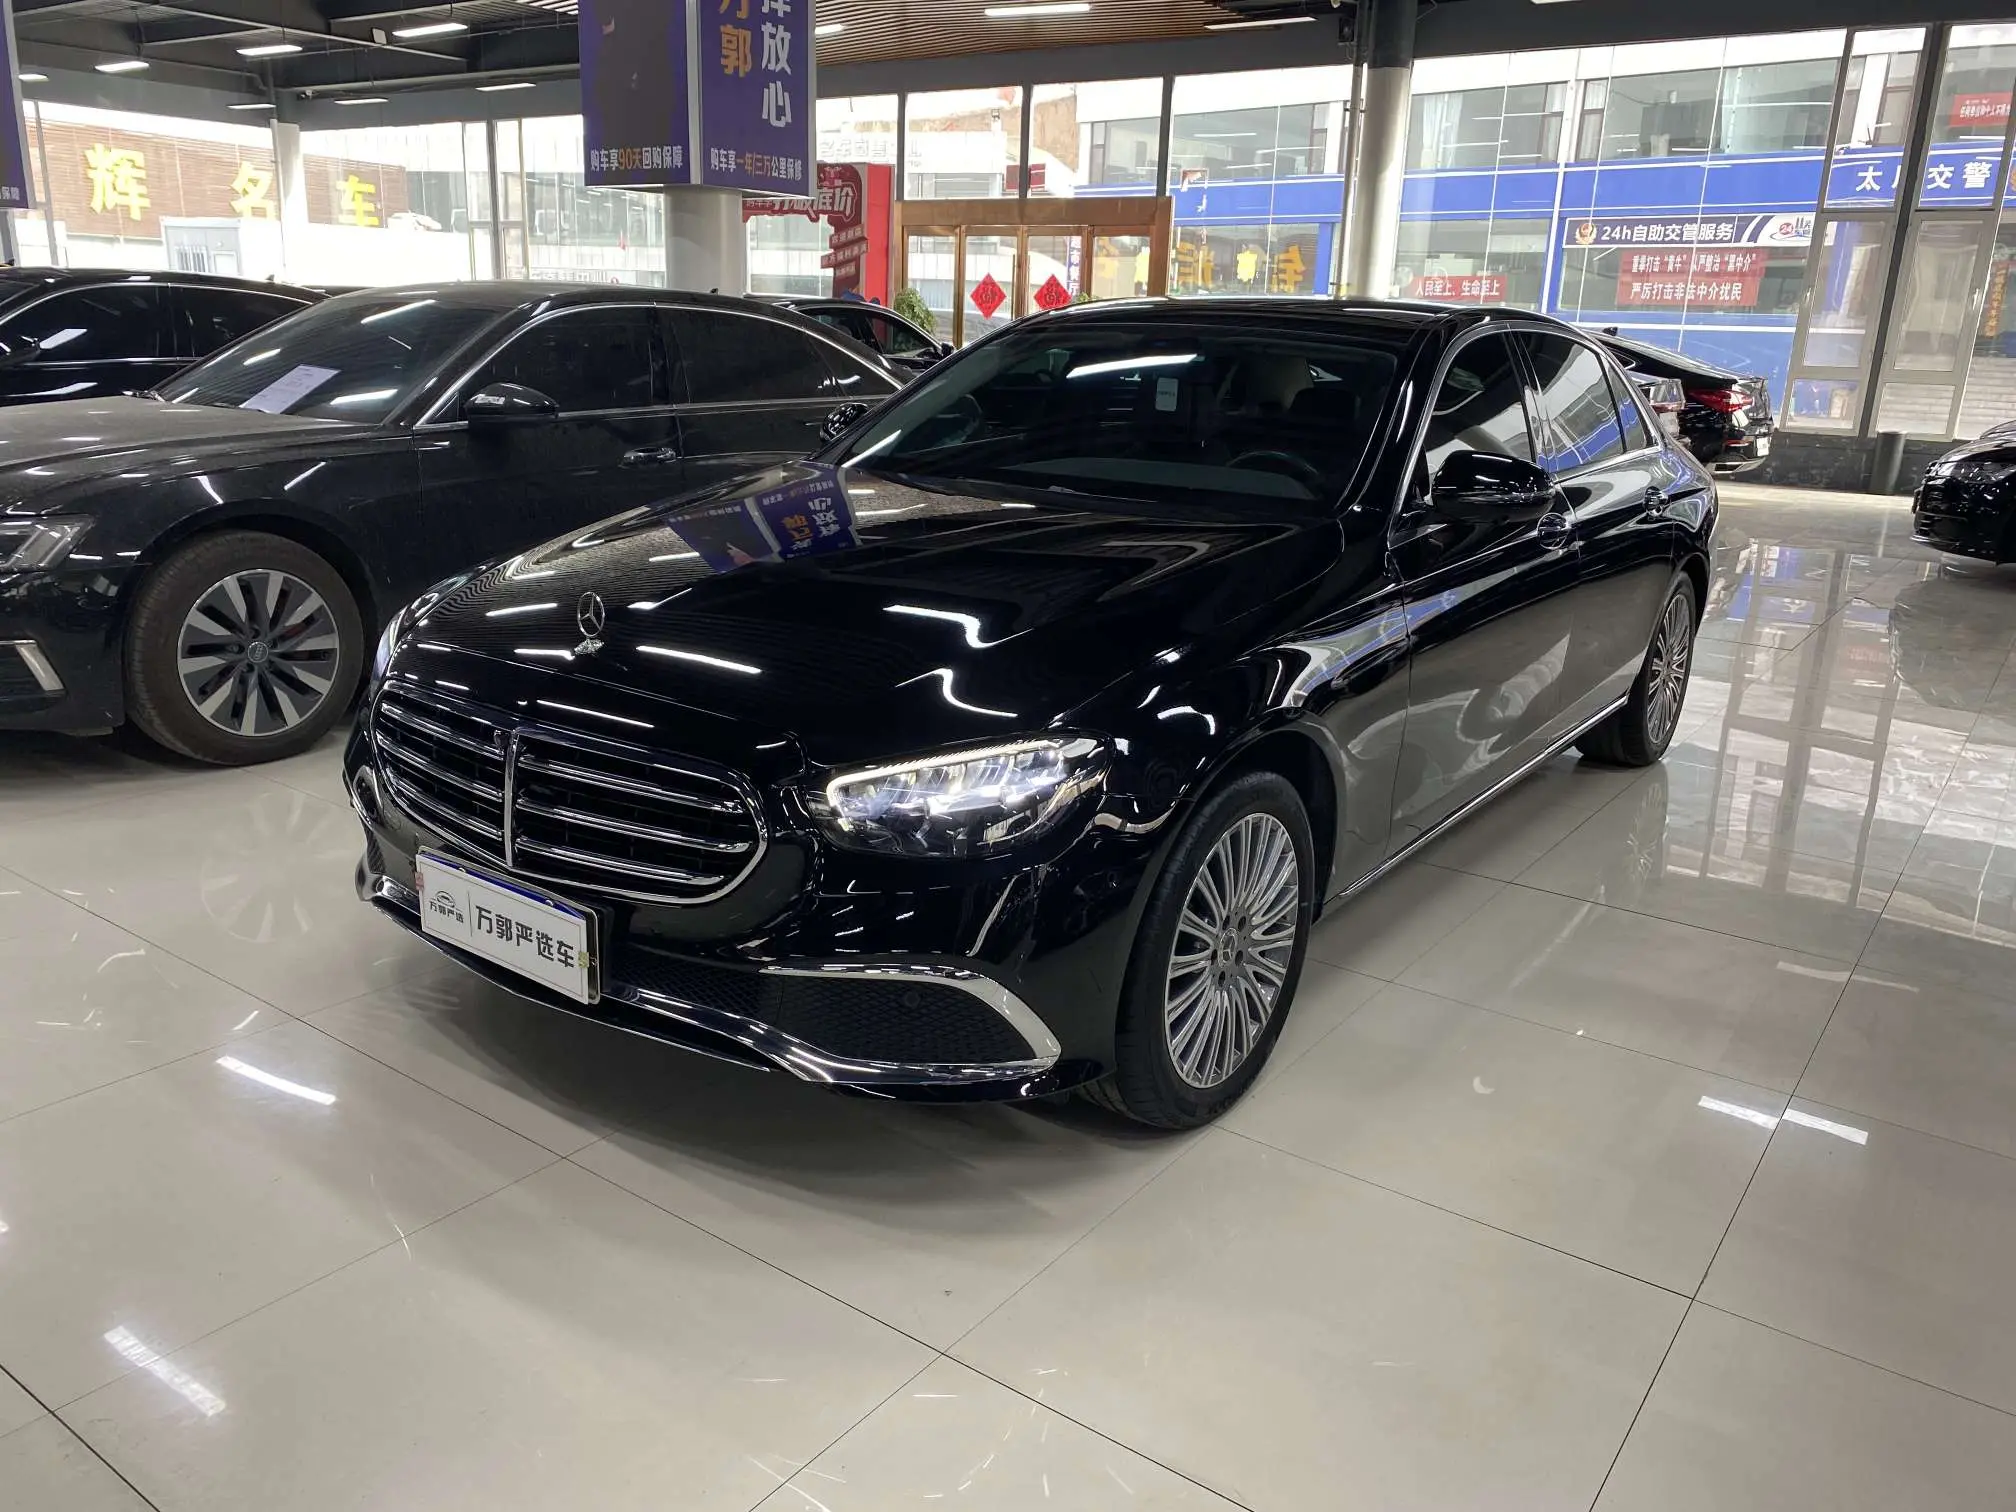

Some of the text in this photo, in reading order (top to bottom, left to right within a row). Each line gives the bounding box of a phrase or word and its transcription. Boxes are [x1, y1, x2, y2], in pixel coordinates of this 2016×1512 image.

[590, 145, 683, 172] 购车享90天回购保障
[1856, 161, 1992, 192] 太交警
[1601, 223, 1733, 242] 24h自助交管服务
[1631, 282, 1743, 301] 严厉打击非法中介扰民
[476, 905, 574, 968] 万郭严选车
